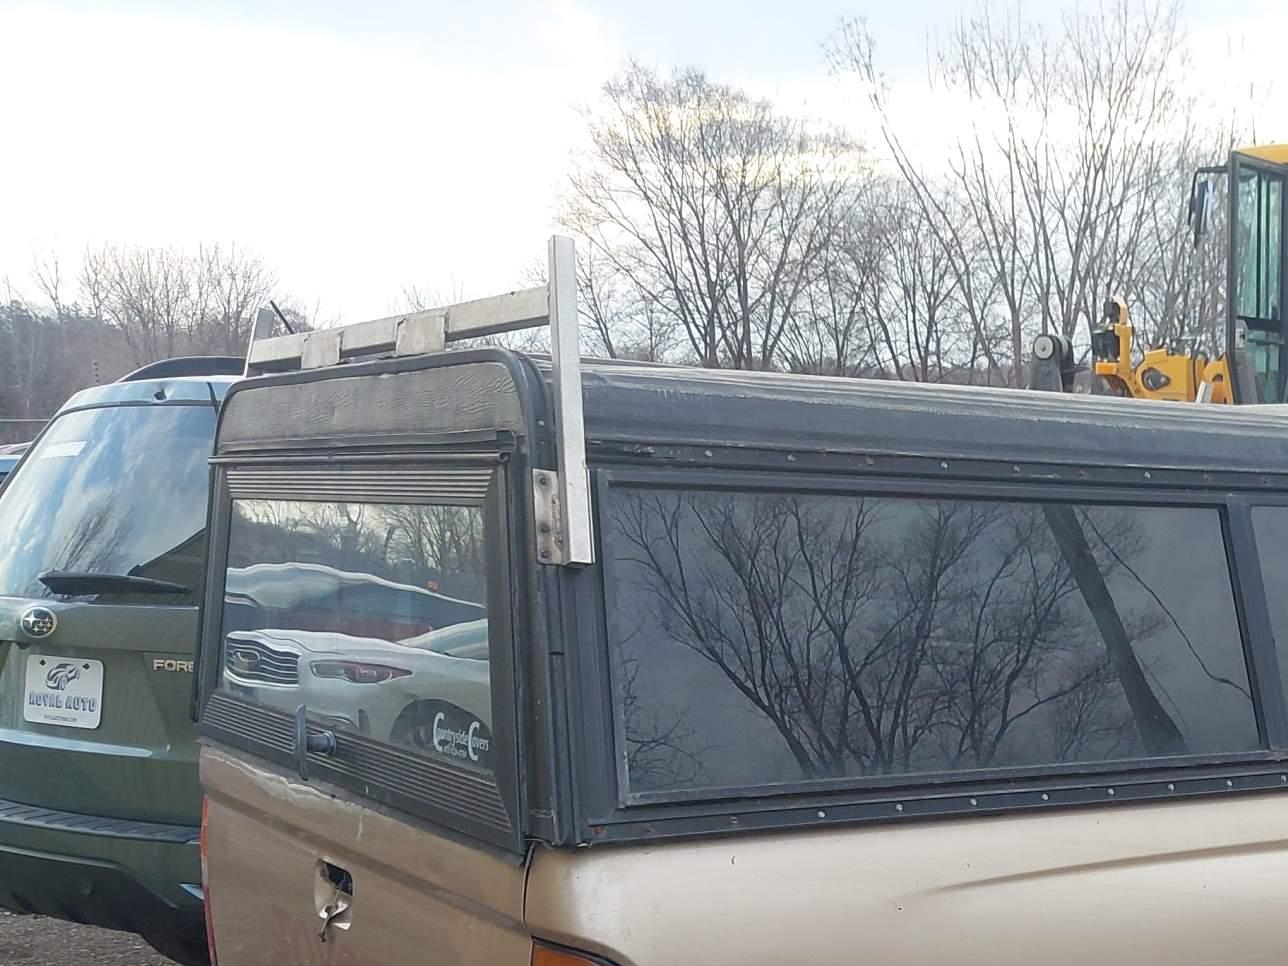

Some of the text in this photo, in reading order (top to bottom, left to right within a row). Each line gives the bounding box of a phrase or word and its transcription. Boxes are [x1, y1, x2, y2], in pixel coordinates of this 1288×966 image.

[28, 691, 97, 712] ROYAL AUTO
[433, 711, 489, 761] Countryside Covers
